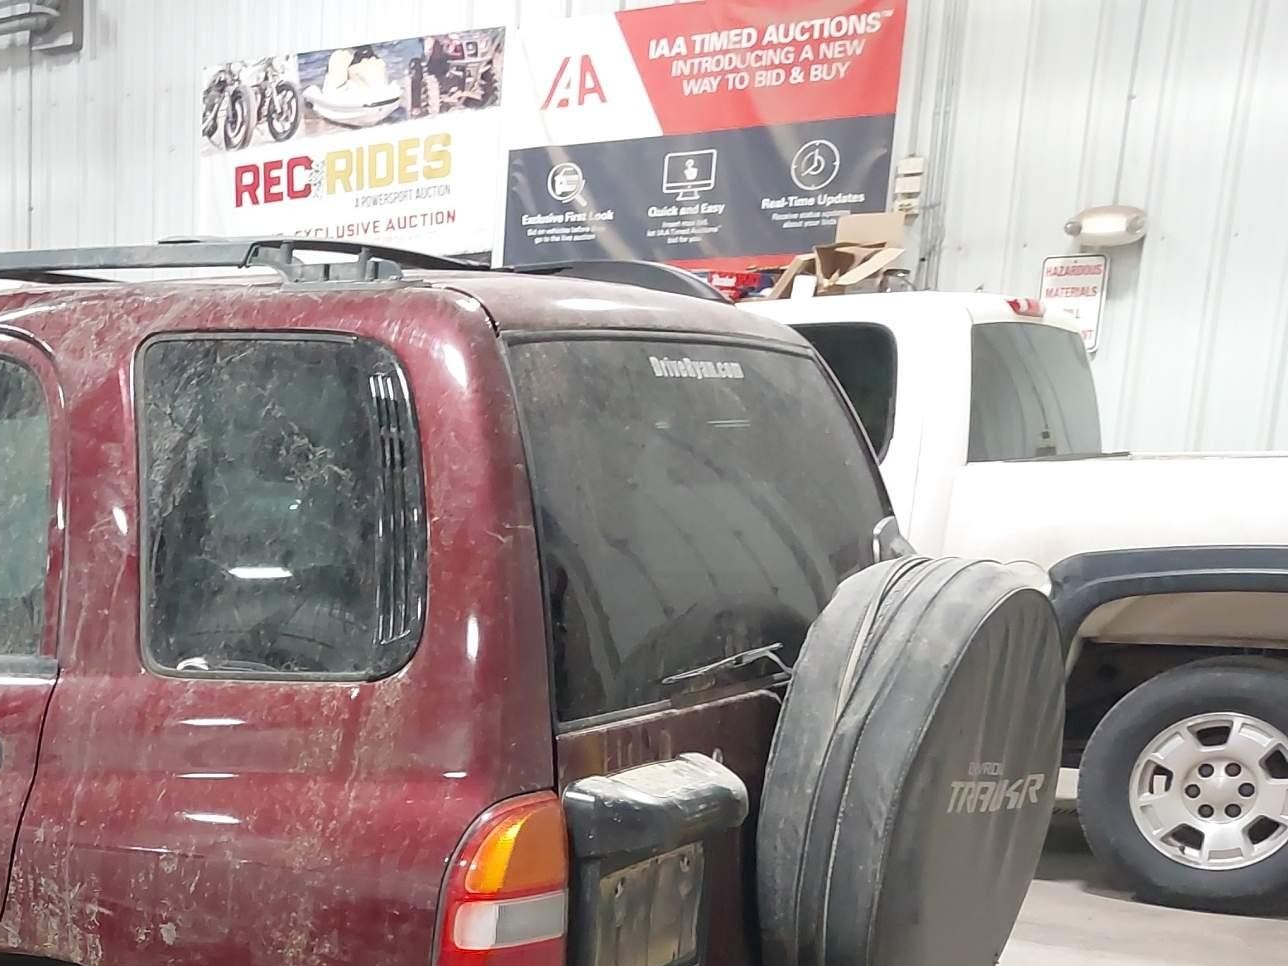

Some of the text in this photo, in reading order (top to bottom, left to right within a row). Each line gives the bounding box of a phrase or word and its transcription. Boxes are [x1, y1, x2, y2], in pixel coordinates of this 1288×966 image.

[649, 36, 687, 59] IAA
[691, 28, 757, 51] TIMED
[671, 39, 866, 76] INTRODUCING A NEW
[682, 61, 850, 96] WAY TO BID & BUY
[235, 132, 452, 207] REC RIDES
[415, 183, 451, 200] AUCTION
[817, 192, 865, 207] Updates
[385, 209, 456, 232] AUCTION
[648, 202, 725, 217] Quick and Easy
[1045, 286, 1098, 297] MATERIALS
[946, 773, 1045, 813] TRACKR
